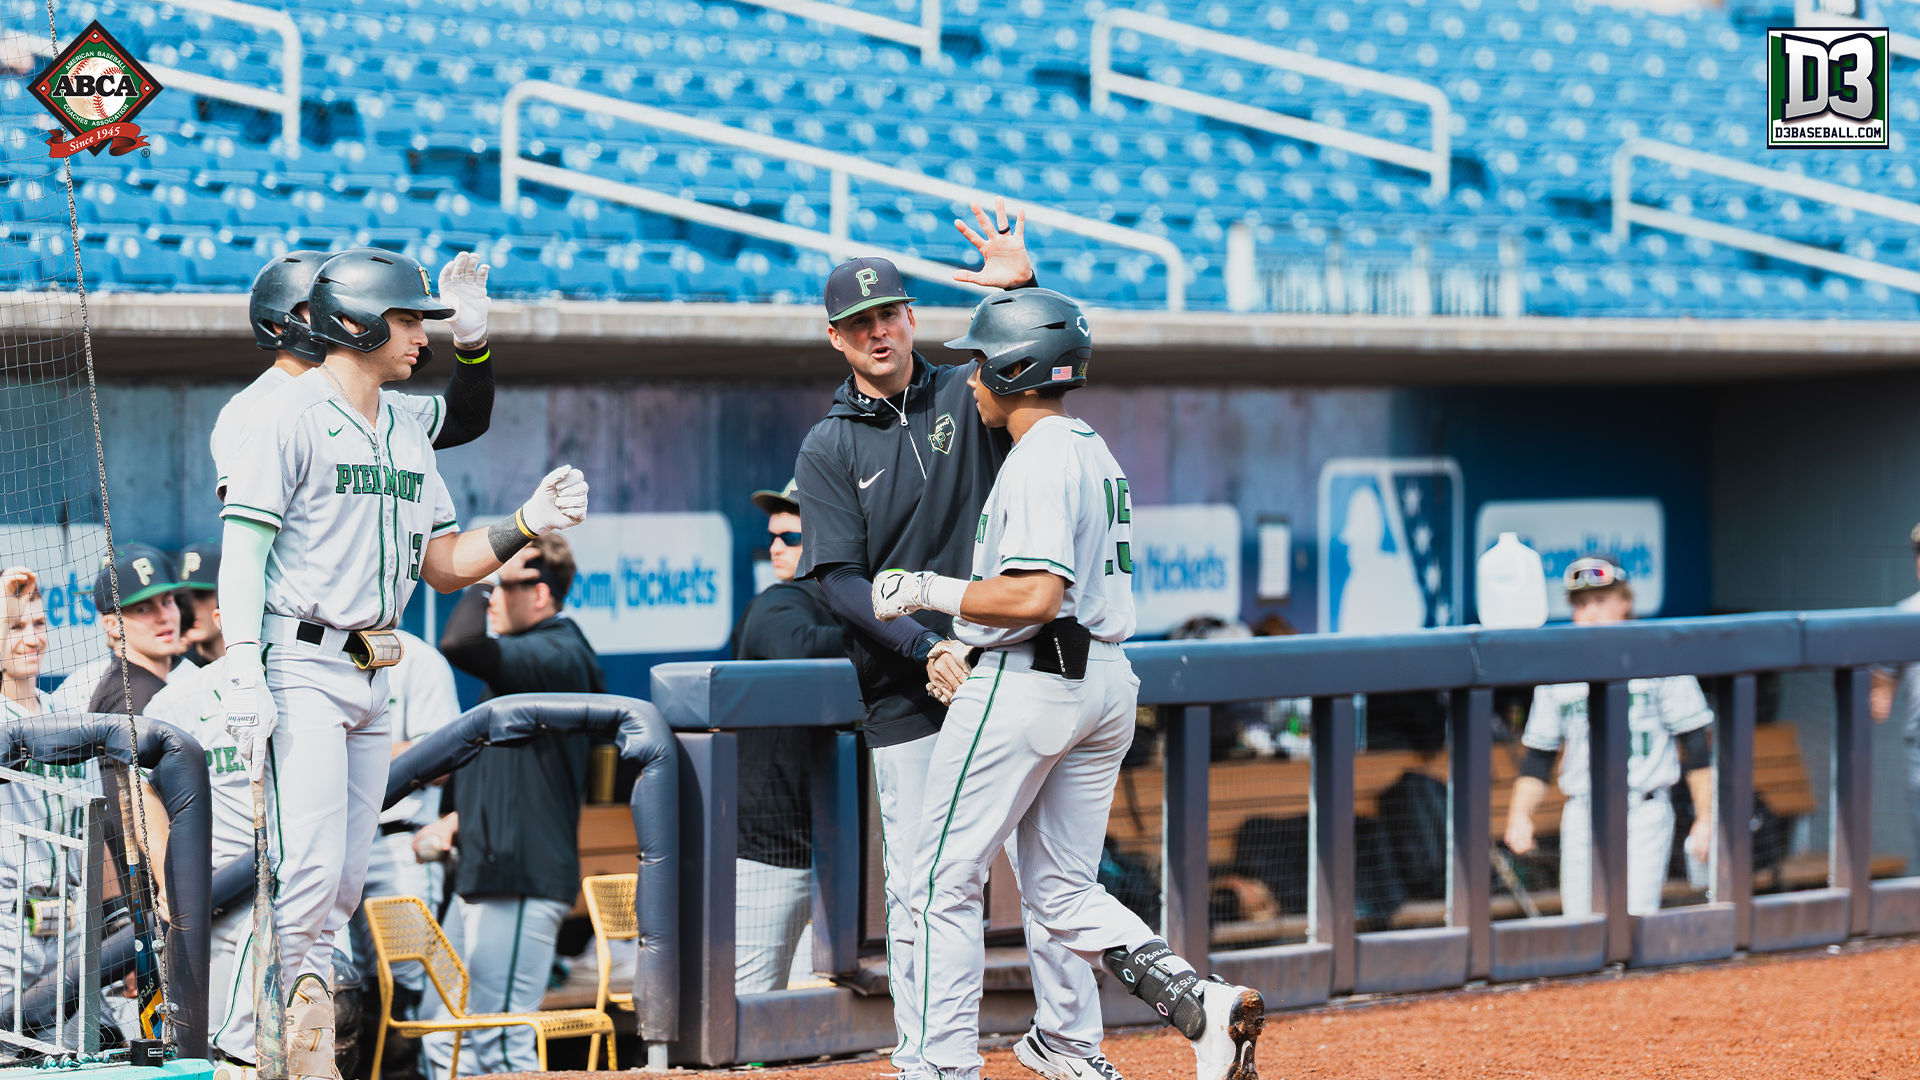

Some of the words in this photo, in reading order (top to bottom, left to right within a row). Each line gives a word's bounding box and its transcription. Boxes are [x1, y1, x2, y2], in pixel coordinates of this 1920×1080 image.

[855, 267, 879, 297] P
[406, 531, 423, 581] 13
[204, 746, 246, 774] PIE
